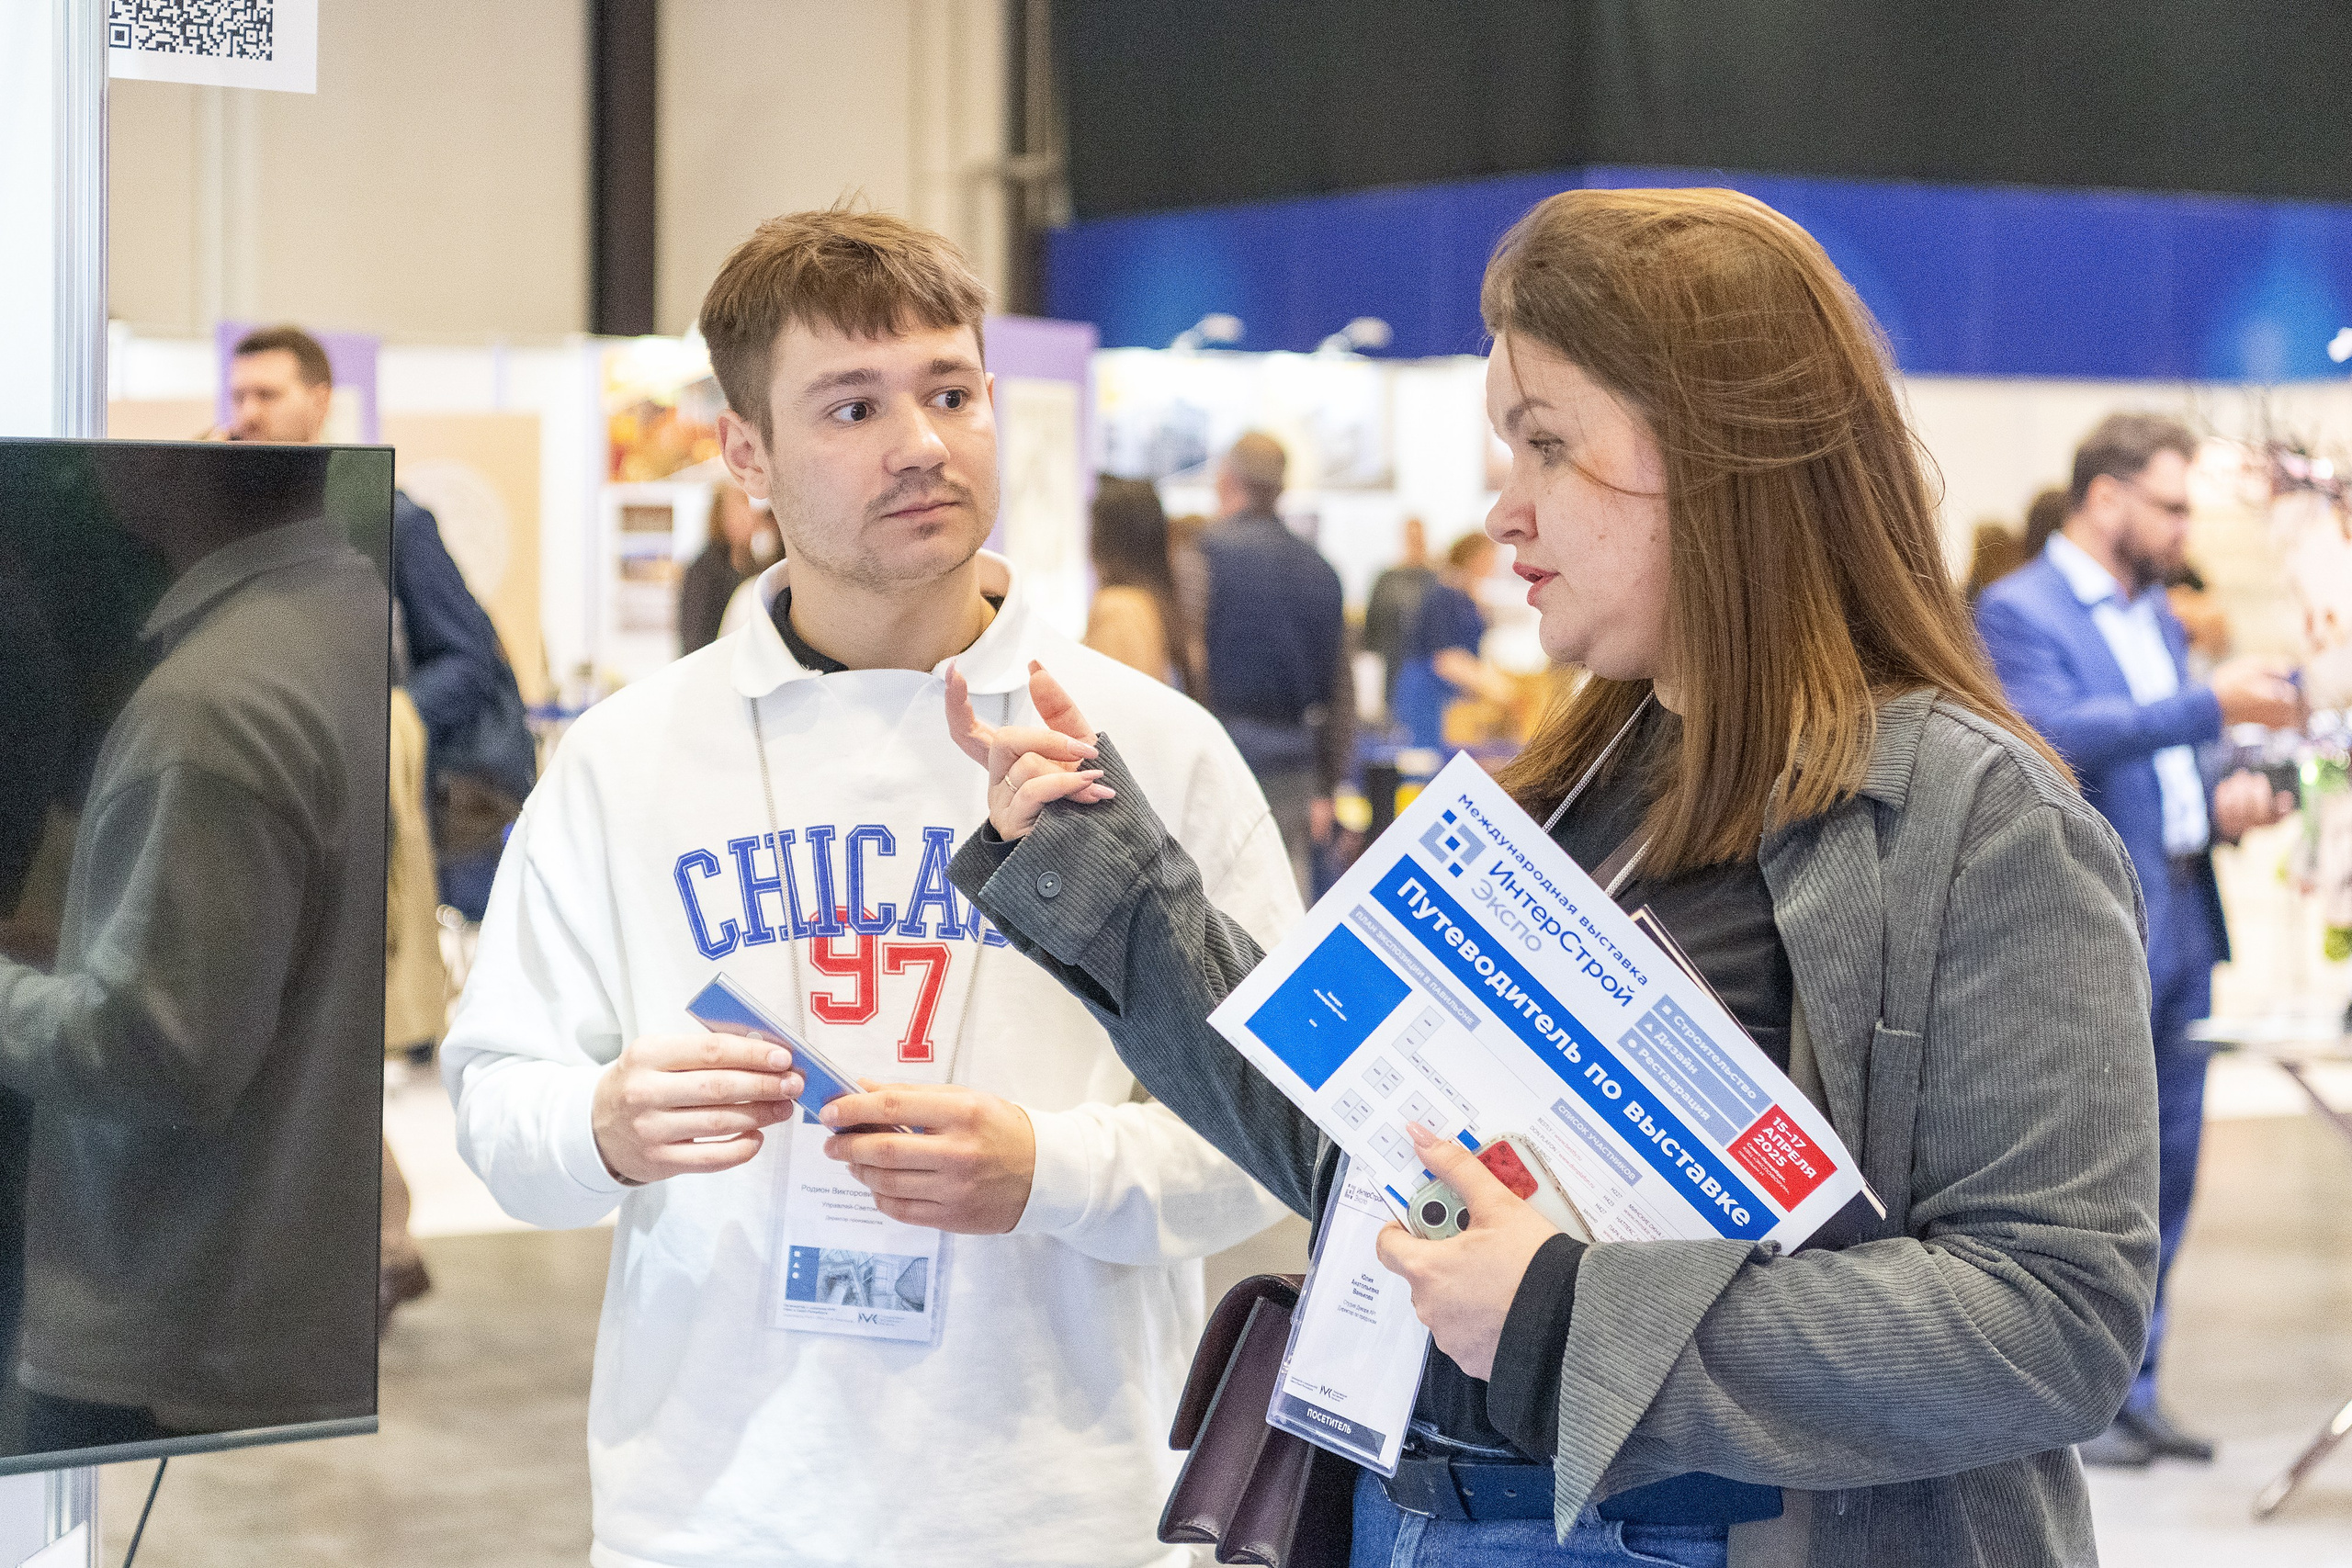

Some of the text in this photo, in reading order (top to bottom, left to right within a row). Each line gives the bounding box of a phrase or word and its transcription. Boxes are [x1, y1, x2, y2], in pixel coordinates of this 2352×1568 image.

[673, 824, 1011, 961] CHICA
[1457, 794, 1650, 986] Международная выставка
[1470, 878, 1545, 953] Экспо
[1355, 911, 1376, 932] ПЛАН
[1376, 931, 1424, 978] ЭКСПОЗИЦИИ
[1429, 982, 1474, 1024] ПАВИЛЬОНЕ
[1487, 860, 1638, 1008] ИнтерСтрой
[809, 905, 951, 1064] 97
[1396, 877, 1751, 1227] Путеводитель по выставке
[1637, 1049, 1711, 1121] Реставрация
[1654, 1031, 1699, 1074] Дизайн
[1671, 1015, 1758, 1100] Строительство
[1558, 1105, 1636, 1179] СПИСОК УЧАСТНИКОВ
[1753, 1134, 1787, 1167] 2025
[1762, 1125, 1816, 1179] АПРЕЛЯ
[831, 1187, 873, 1198] Викторови
[1306, 1407, 1351, 1435] ПОСЕТИТЕЛЬ
